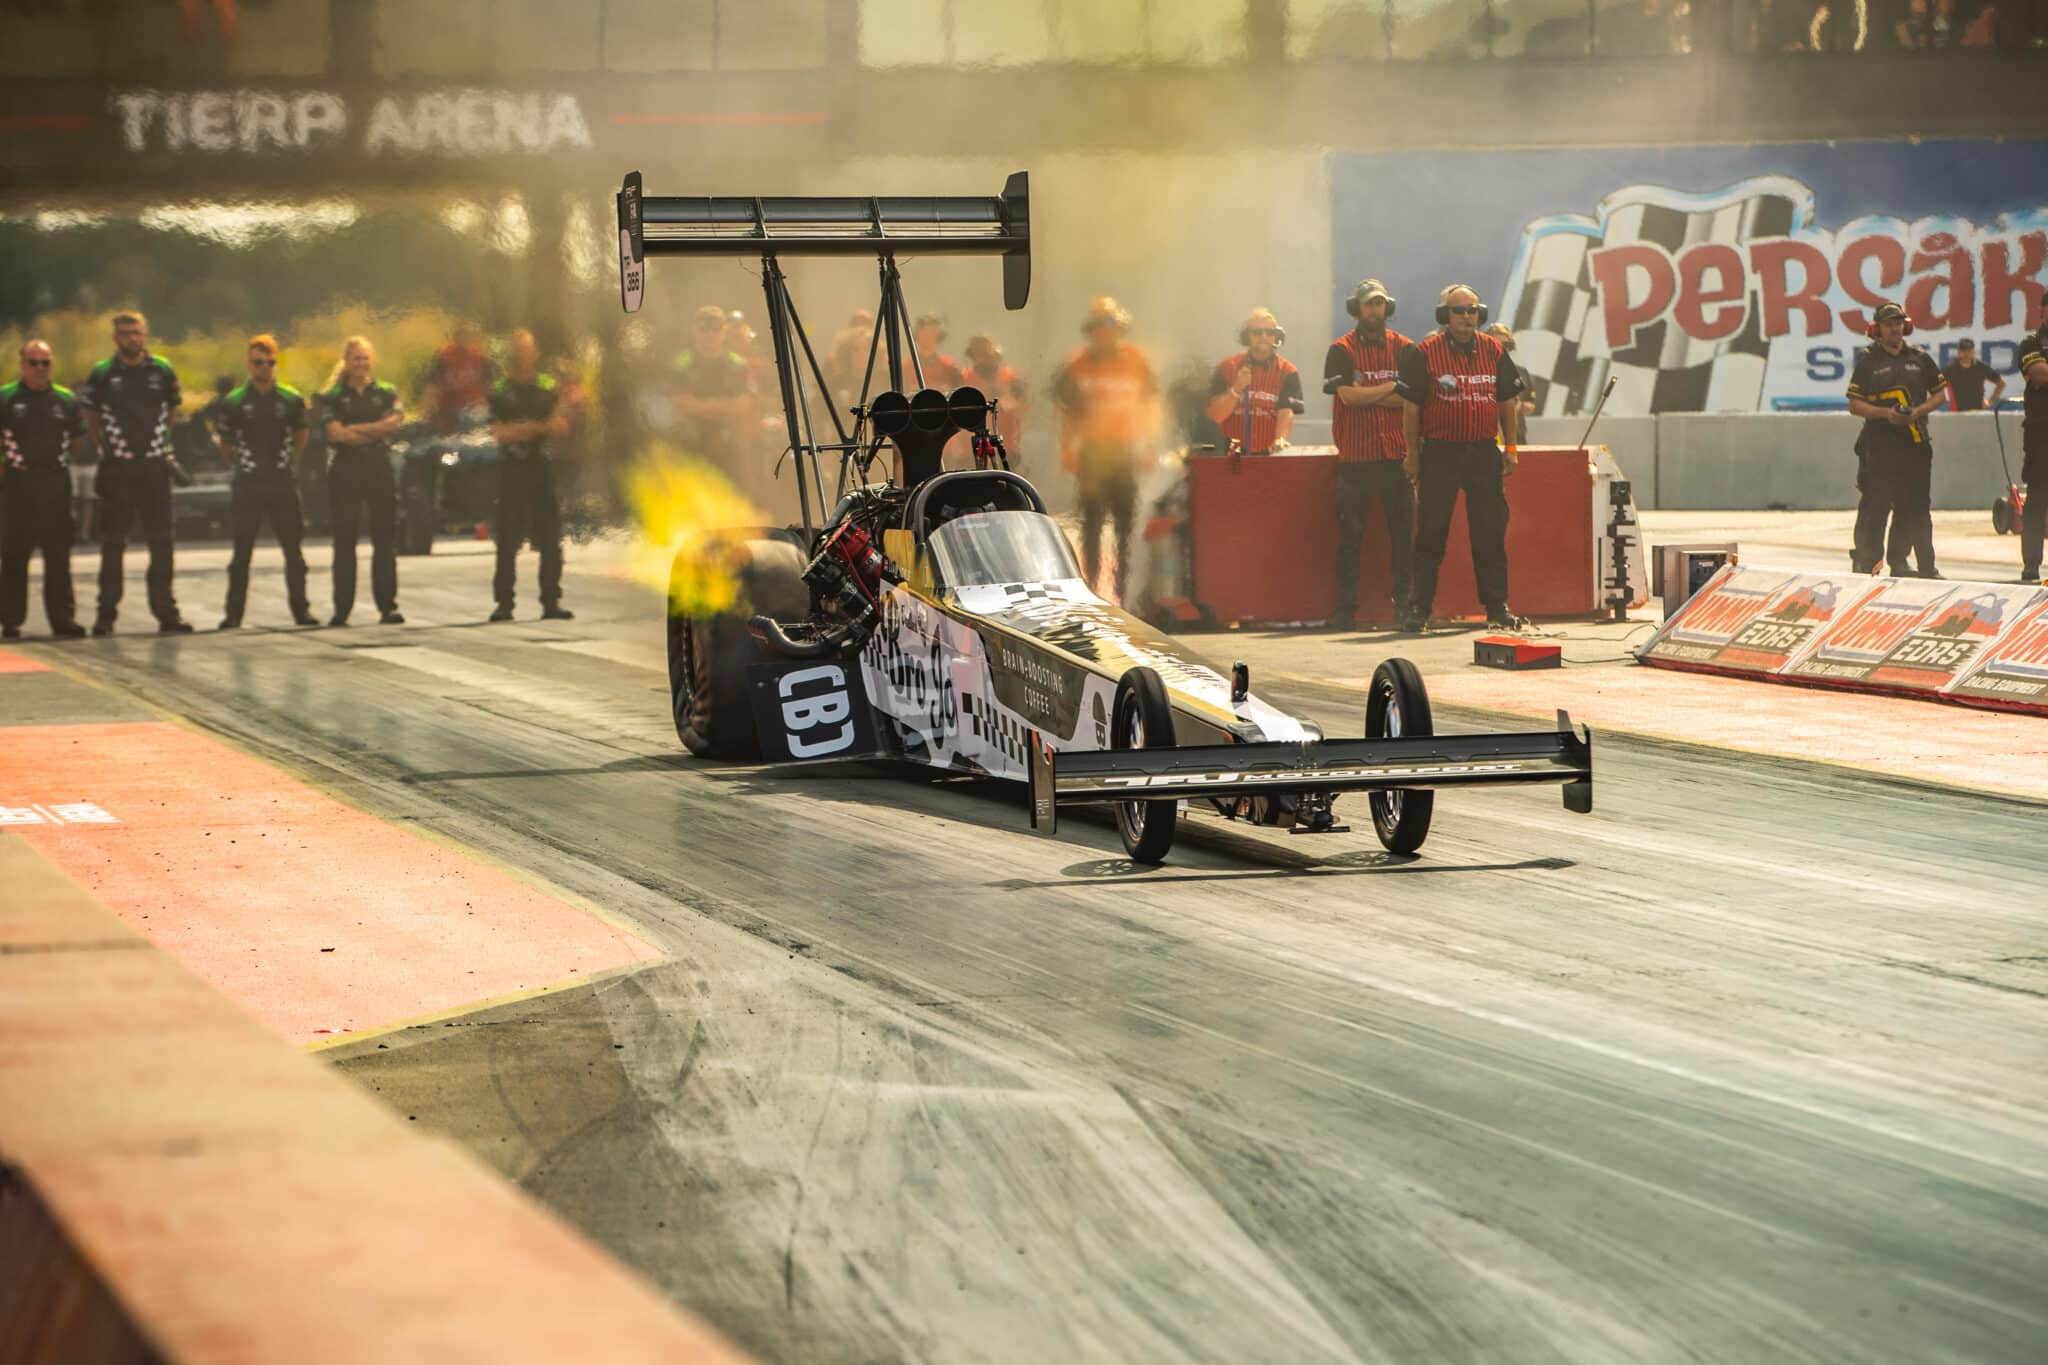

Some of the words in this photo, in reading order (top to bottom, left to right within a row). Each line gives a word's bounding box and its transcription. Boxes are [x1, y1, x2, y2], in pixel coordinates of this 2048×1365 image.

[117, 90, 347, 152] TIERP
[365, 90, 593, 154] ARENA
[1735, 622, 1804, 649] EDRS
[1889, 637, 1971, 665] EDRS
[1002, 647, 1063, 695] BRAIN-BOOSTING
[1024, 685, 1050, 716] COFFEE
[1243, 763, 1521, 782] MOTORSPORT
